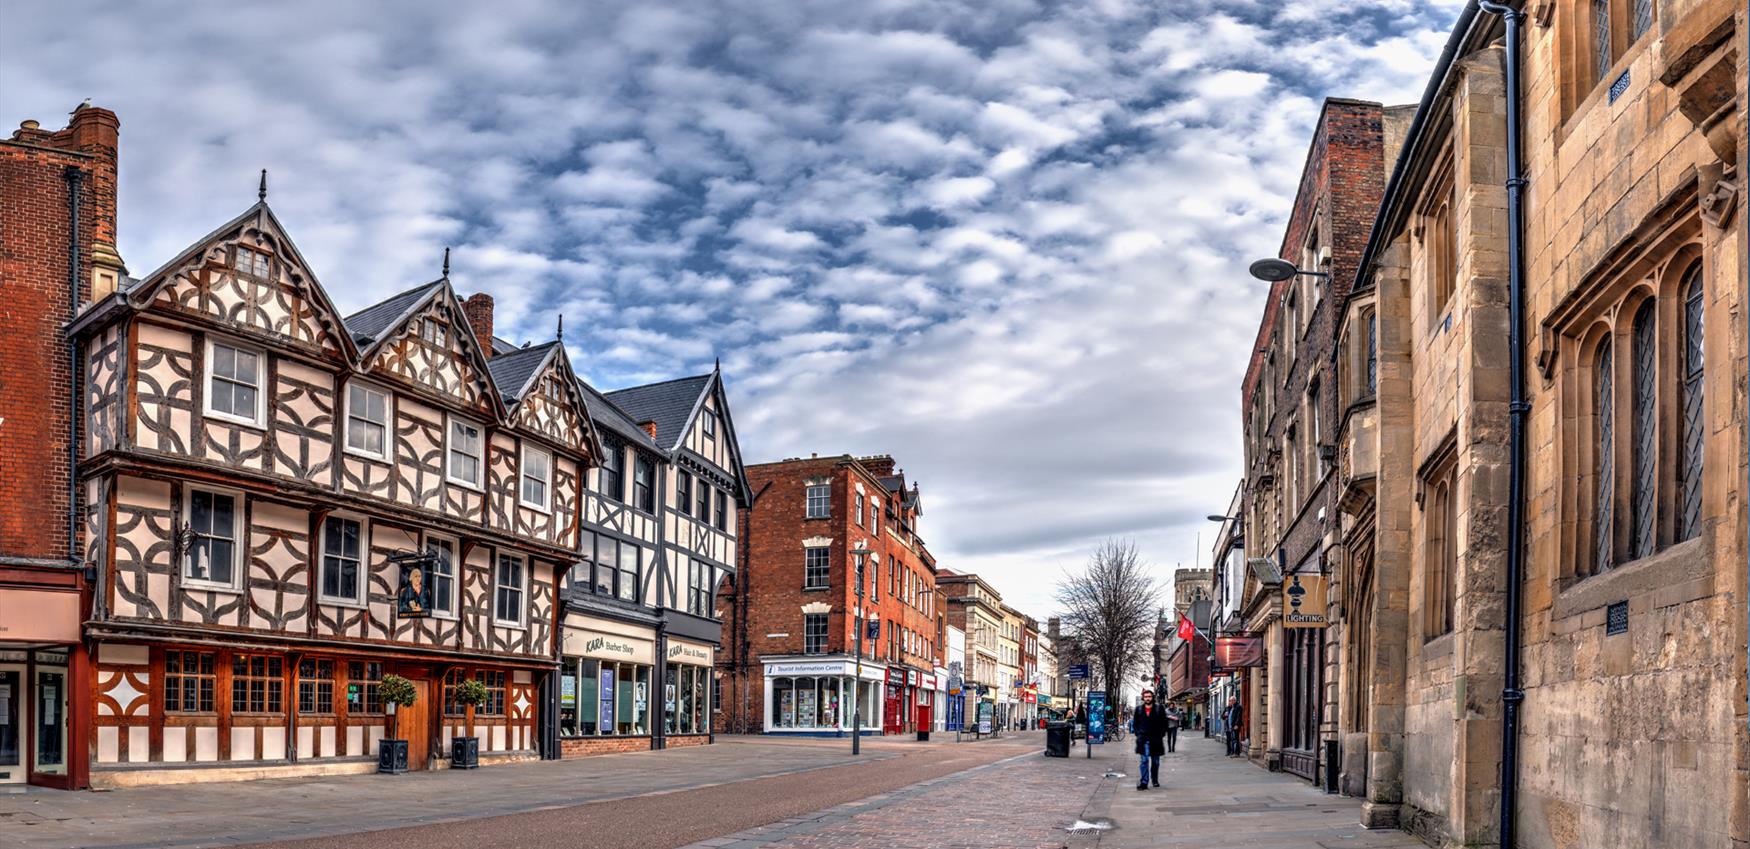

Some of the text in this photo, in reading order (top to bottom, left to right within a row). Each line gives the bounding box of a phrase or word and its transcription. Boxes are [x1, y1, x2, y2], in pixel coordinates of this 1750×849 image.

[586, 637, 635, 655] KARA Barber Shop
[669, 644, 683, 658] KARA
